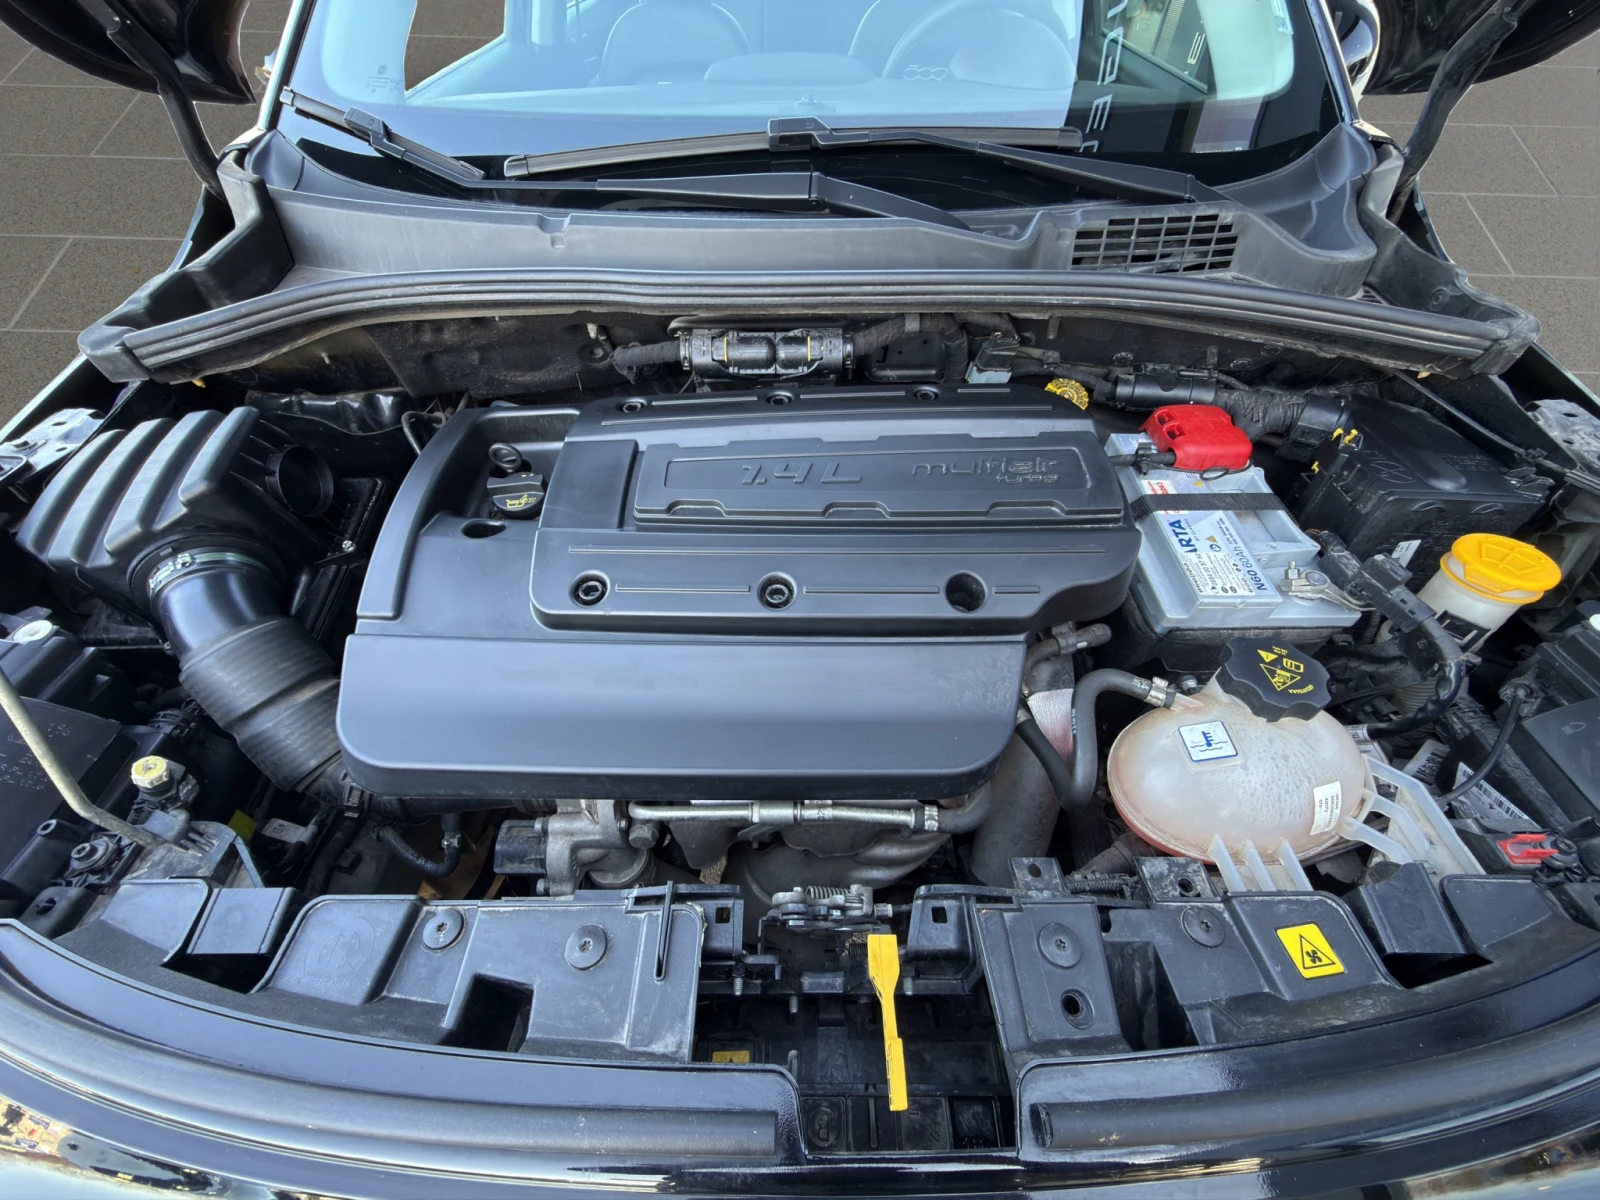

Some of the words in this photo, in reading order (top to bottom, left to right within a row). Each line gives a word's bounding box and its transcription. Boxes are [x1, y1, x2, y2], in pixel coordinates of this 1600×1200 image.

[912, 456, 1059, 477] multiair
[1233, 546, 1253, 568] 60Ah
[1247, 570, 1267, 591] N60
